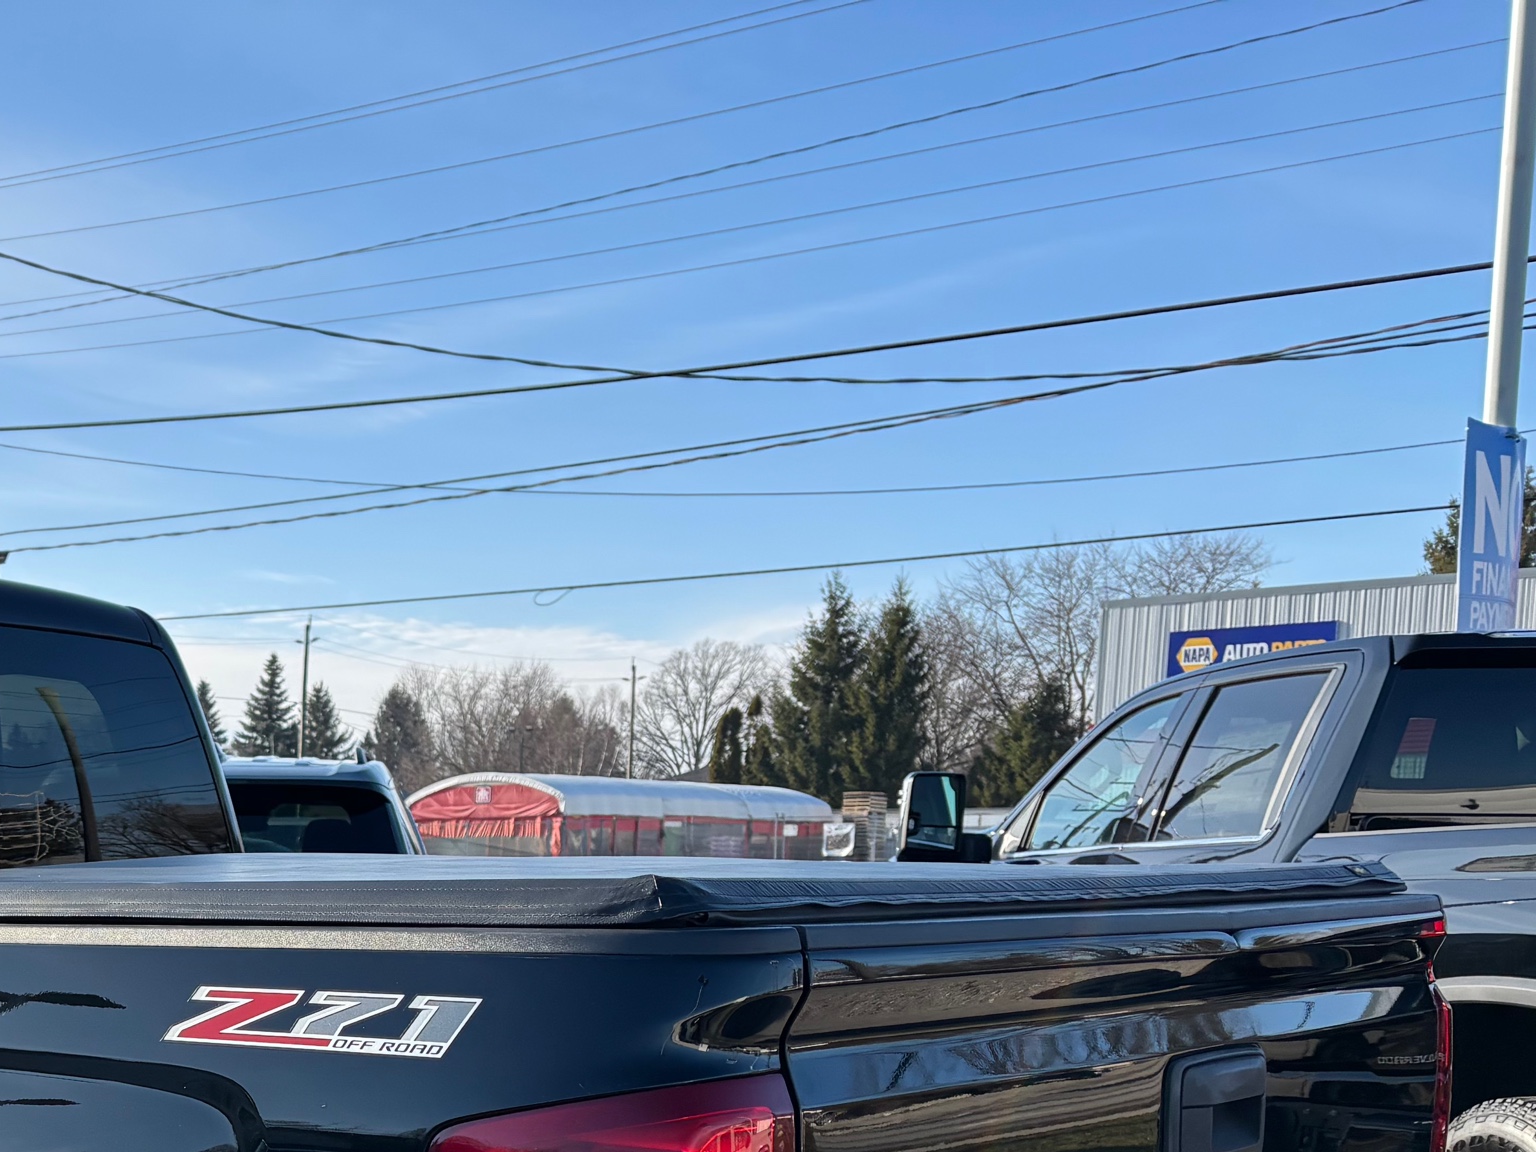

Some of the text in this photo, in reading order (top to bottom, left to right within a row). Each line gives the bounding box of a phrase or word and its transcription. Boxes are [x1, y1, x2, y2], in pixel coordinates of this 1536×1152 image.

[1182, 647, 1212, 663] NAPA
[161, 985, 483, 1050] Z71
[332, 1038, 444, 1055] OFF ROAD
